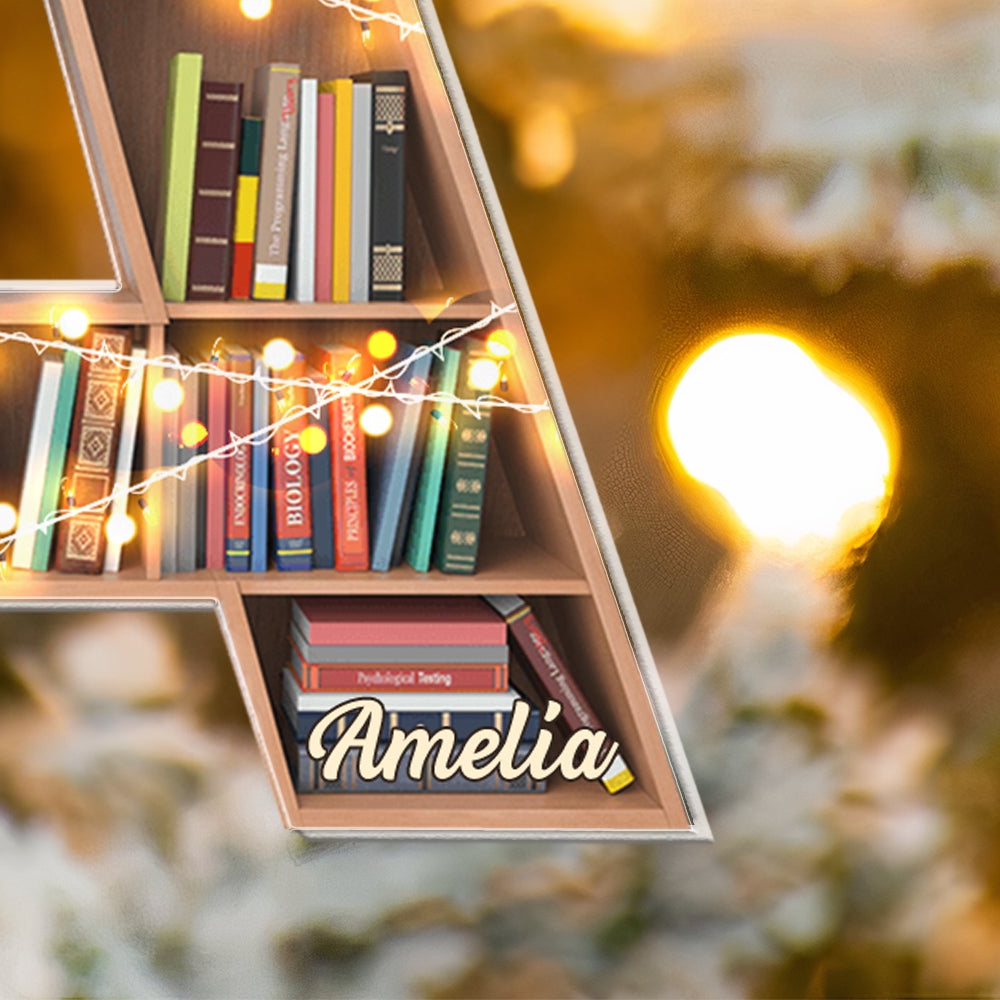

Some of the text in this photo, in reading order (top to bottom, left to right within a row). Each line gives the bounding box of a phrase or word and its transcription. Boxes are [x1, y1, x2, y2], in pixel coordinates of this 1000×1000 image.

[268, 235, 280, 256] The
[234, 442, 247, 526] ENDOCRINOLOG
[283, 429, 303, 526] BIOLOGY
[418, 671, 452, 687] Testing
[307, 697, 619, 783] Amelia
